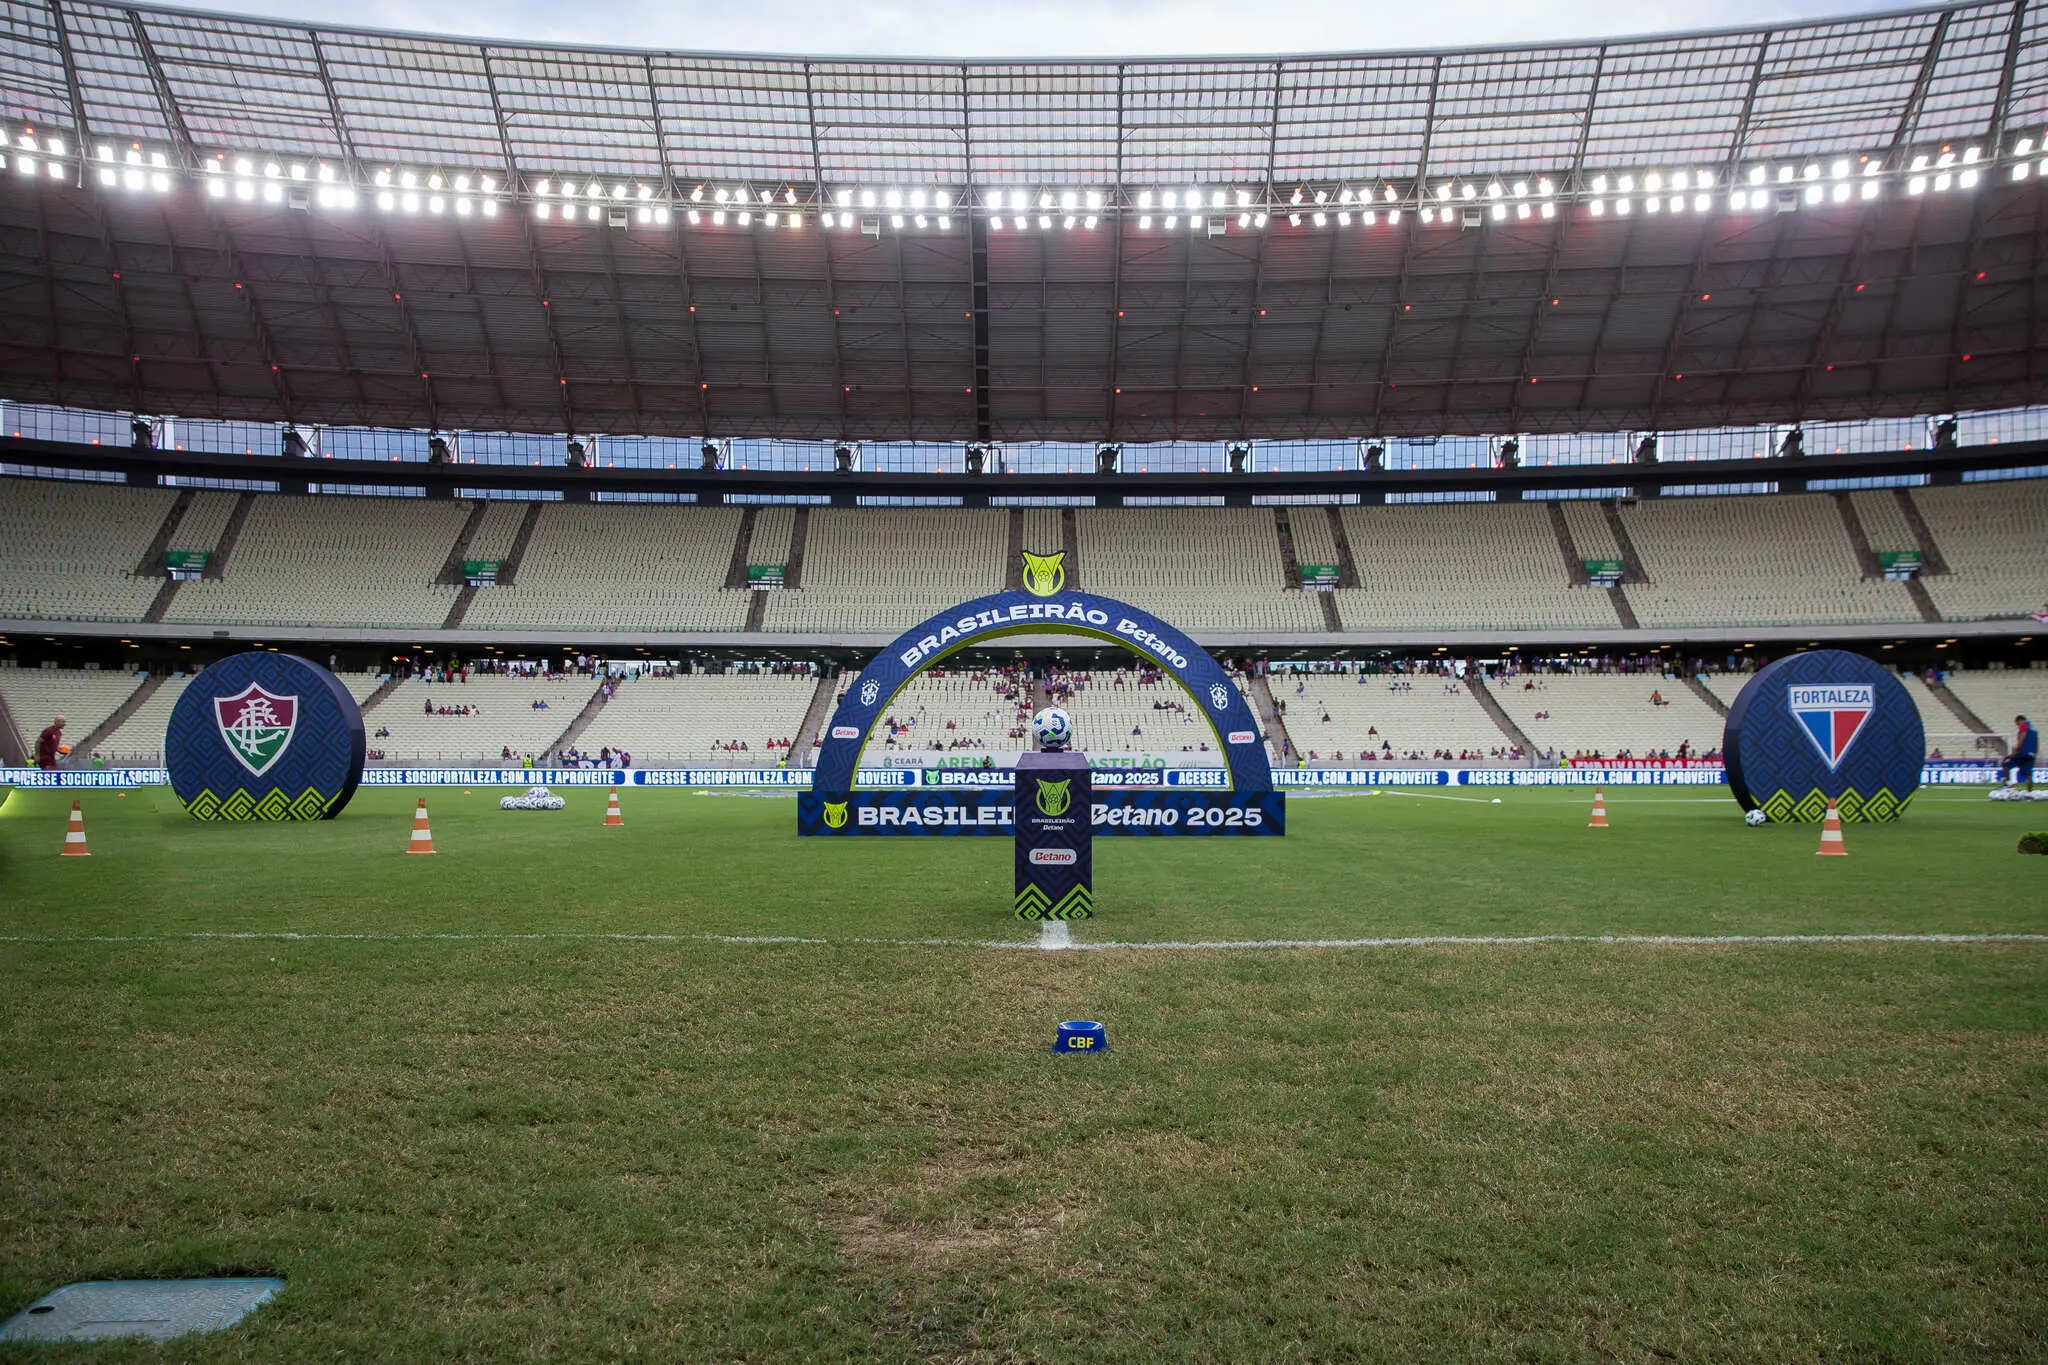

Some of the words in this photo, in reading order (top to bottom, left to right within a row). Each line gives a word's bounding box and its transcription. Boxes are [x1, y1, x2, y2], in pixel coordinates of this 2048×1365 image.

[900, 602, 1109, 668] BRASILEIRÃO
[1115, 618, 1188, 669] Betano
[1793, 689, 1871, 704] FORTALEZA
[894, 756, 924, 765] CEARÁ
[361, 770, 403, 784] ACESSE
[405, 770, 544, 784] SOCIOFORTALEZA.COM.BR
[546, 771, 552, 784] E
[555, 771, 615, 784] APROVEITE
[644, 771, 688, 784] ACESSE
[856, 771, 905, 784] ROVEITE
[1125, 772, 1159, 784] 2025
[1178, 771, 1221, 784] ACESSE
[1370, 771, 1377, 784] E
[1378, 771, 1439, 784] APROVEITE
[1468, 771, 1511, 785] ACESSE
[1513, 771, 1652, 785] SOCIOFORTALEZA.COM.BR
[1654, 771, 1660, 784] E
[1663, 771, 1722, 785] APROVEITE
[858, 806, 1015, 826] BRASILEI
[1091, 803, 1179, 826] Betano
[1187, 807, 1263, 826] 2025
[1035, 852, 1072, 861] Betano
[1068, 1037, 1095, 1049] CBF
